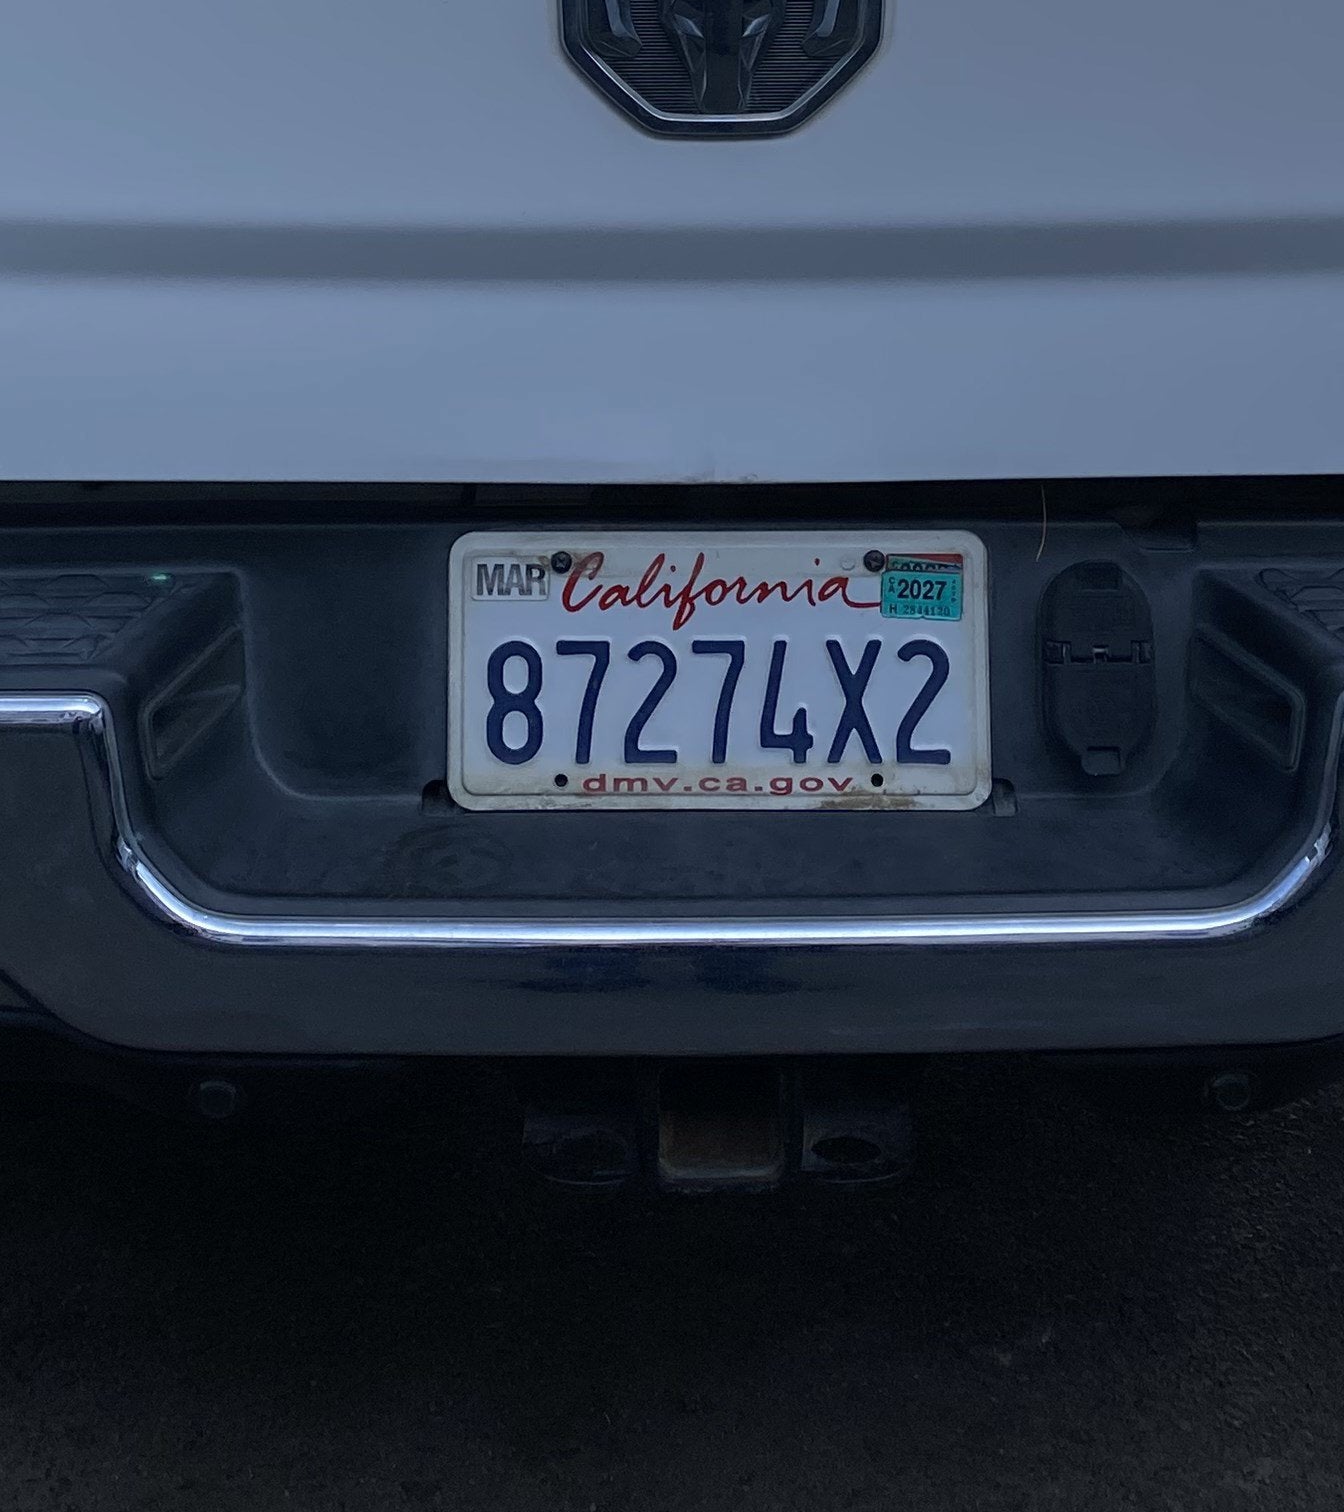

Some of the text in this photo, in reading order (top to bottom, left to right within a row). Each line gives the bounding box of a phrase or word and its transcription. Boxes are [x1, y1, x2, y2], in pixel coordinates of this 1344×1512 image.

[476, 563, 546, 596] MAR
[562, 551, 882, 630] California
[897, 579, 947, 600] 2027
[486, 640, 951, 765] 87274X2
[582, 774, 854, 795] dmv.ca.gov
